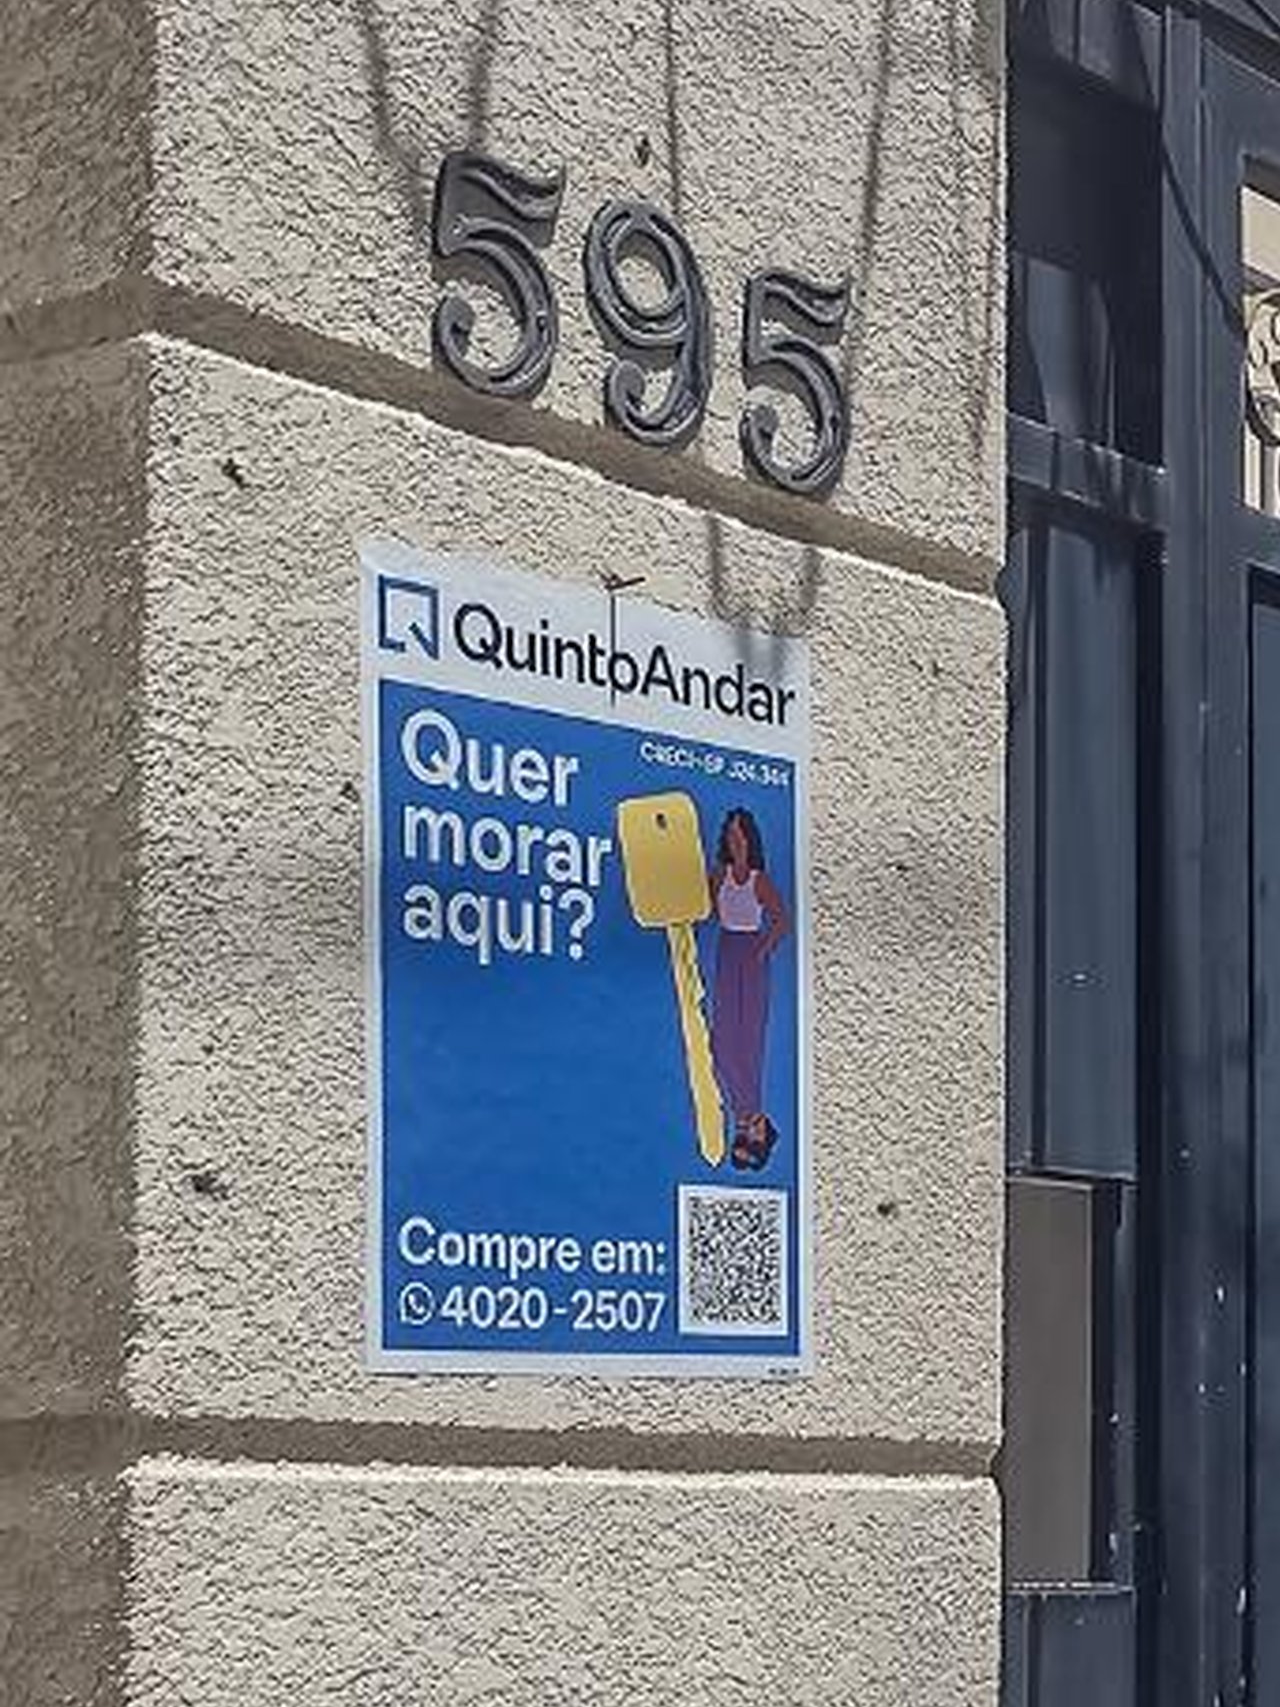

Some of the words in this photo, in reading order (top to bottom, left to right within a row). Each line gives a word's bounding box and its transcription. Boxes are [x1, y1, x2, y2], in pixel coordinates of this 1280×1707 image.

[431, 151, 854, 495] 595
[453, 603, 796, 727] QuintoAndar
[401, 709, 579, 806] Quer
[404, 803, 612, 887] morar
[402, 885, 596, 965] aqui?
[399, 1216, 581, 1280] Compre
[591, 1238, 667, 1276] em:
